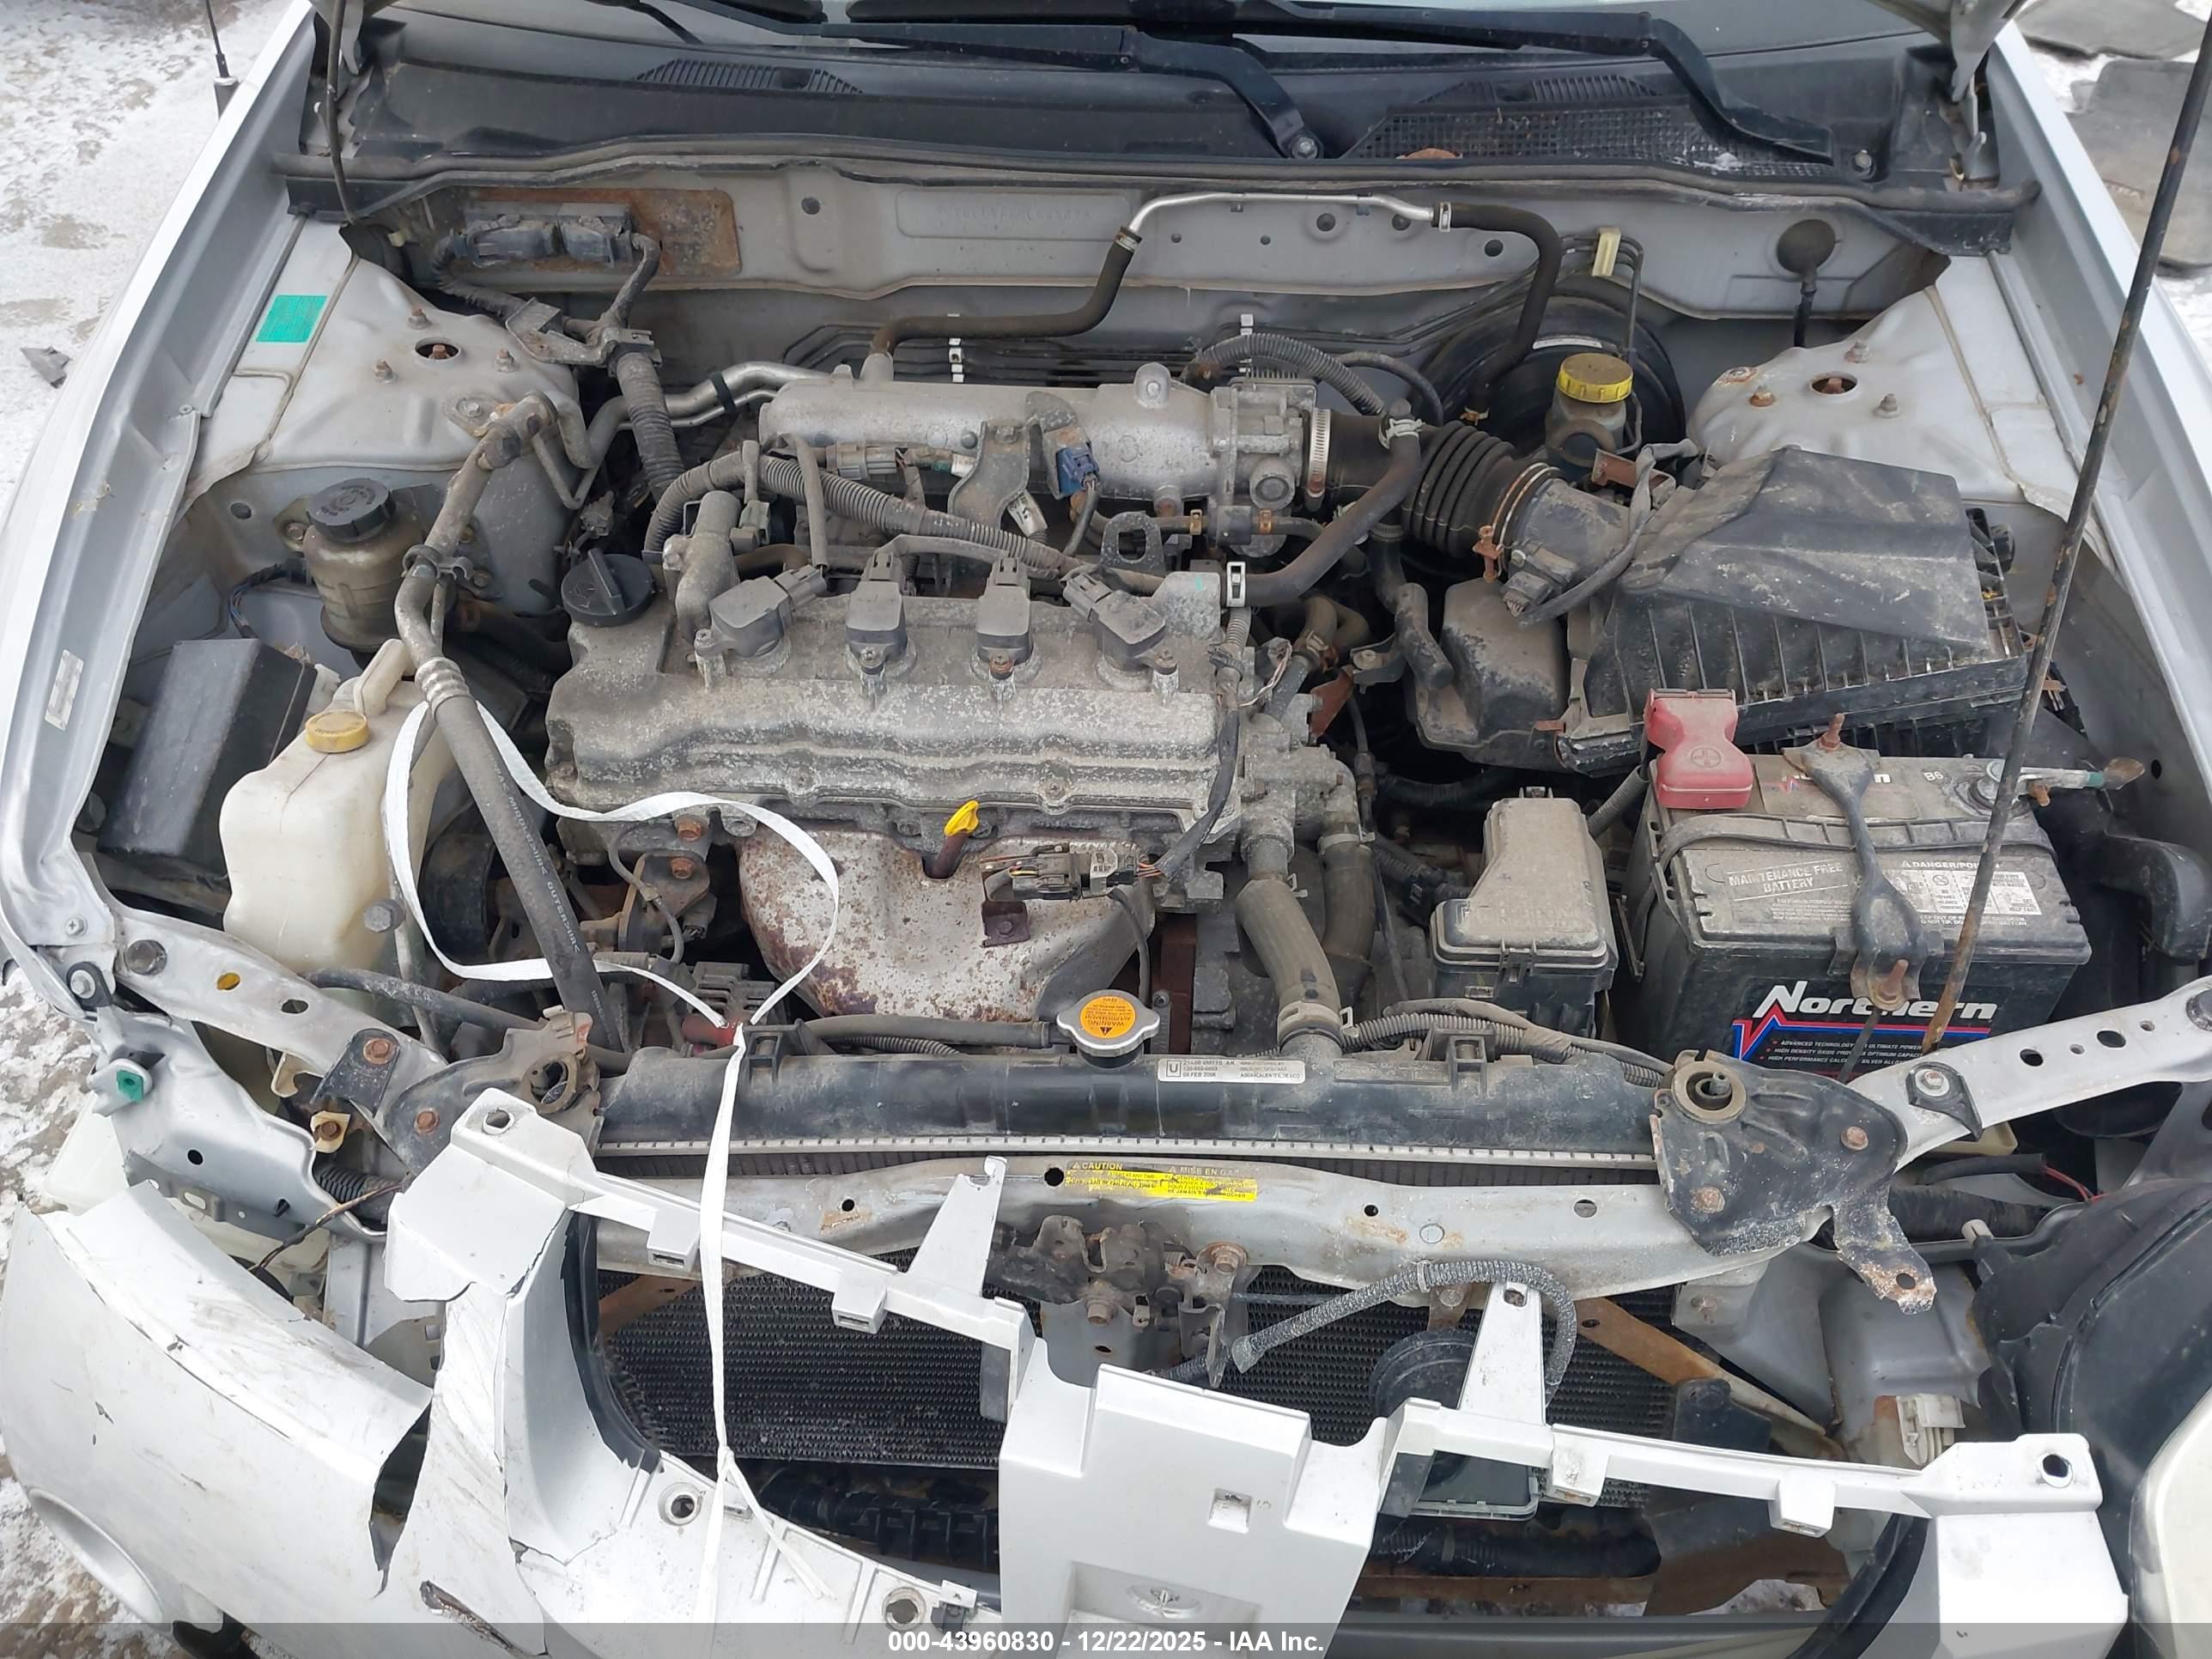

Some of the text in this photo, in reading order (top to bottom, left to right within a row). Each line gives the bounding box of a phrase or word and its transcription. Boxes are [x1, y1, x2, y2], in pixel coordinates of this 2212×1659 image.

[1729, 862, 1844, 886] MAINTENANCE FREE
[1763, 877, 1814, 893] BATTERY
[1170, 1064, 1178, 1073] U
[1082, 1162, 1122, 1170] CAUTION
[1180, 1166, 1202, 1176] MISE
[1205, 1167, 1217, 1176] EN
